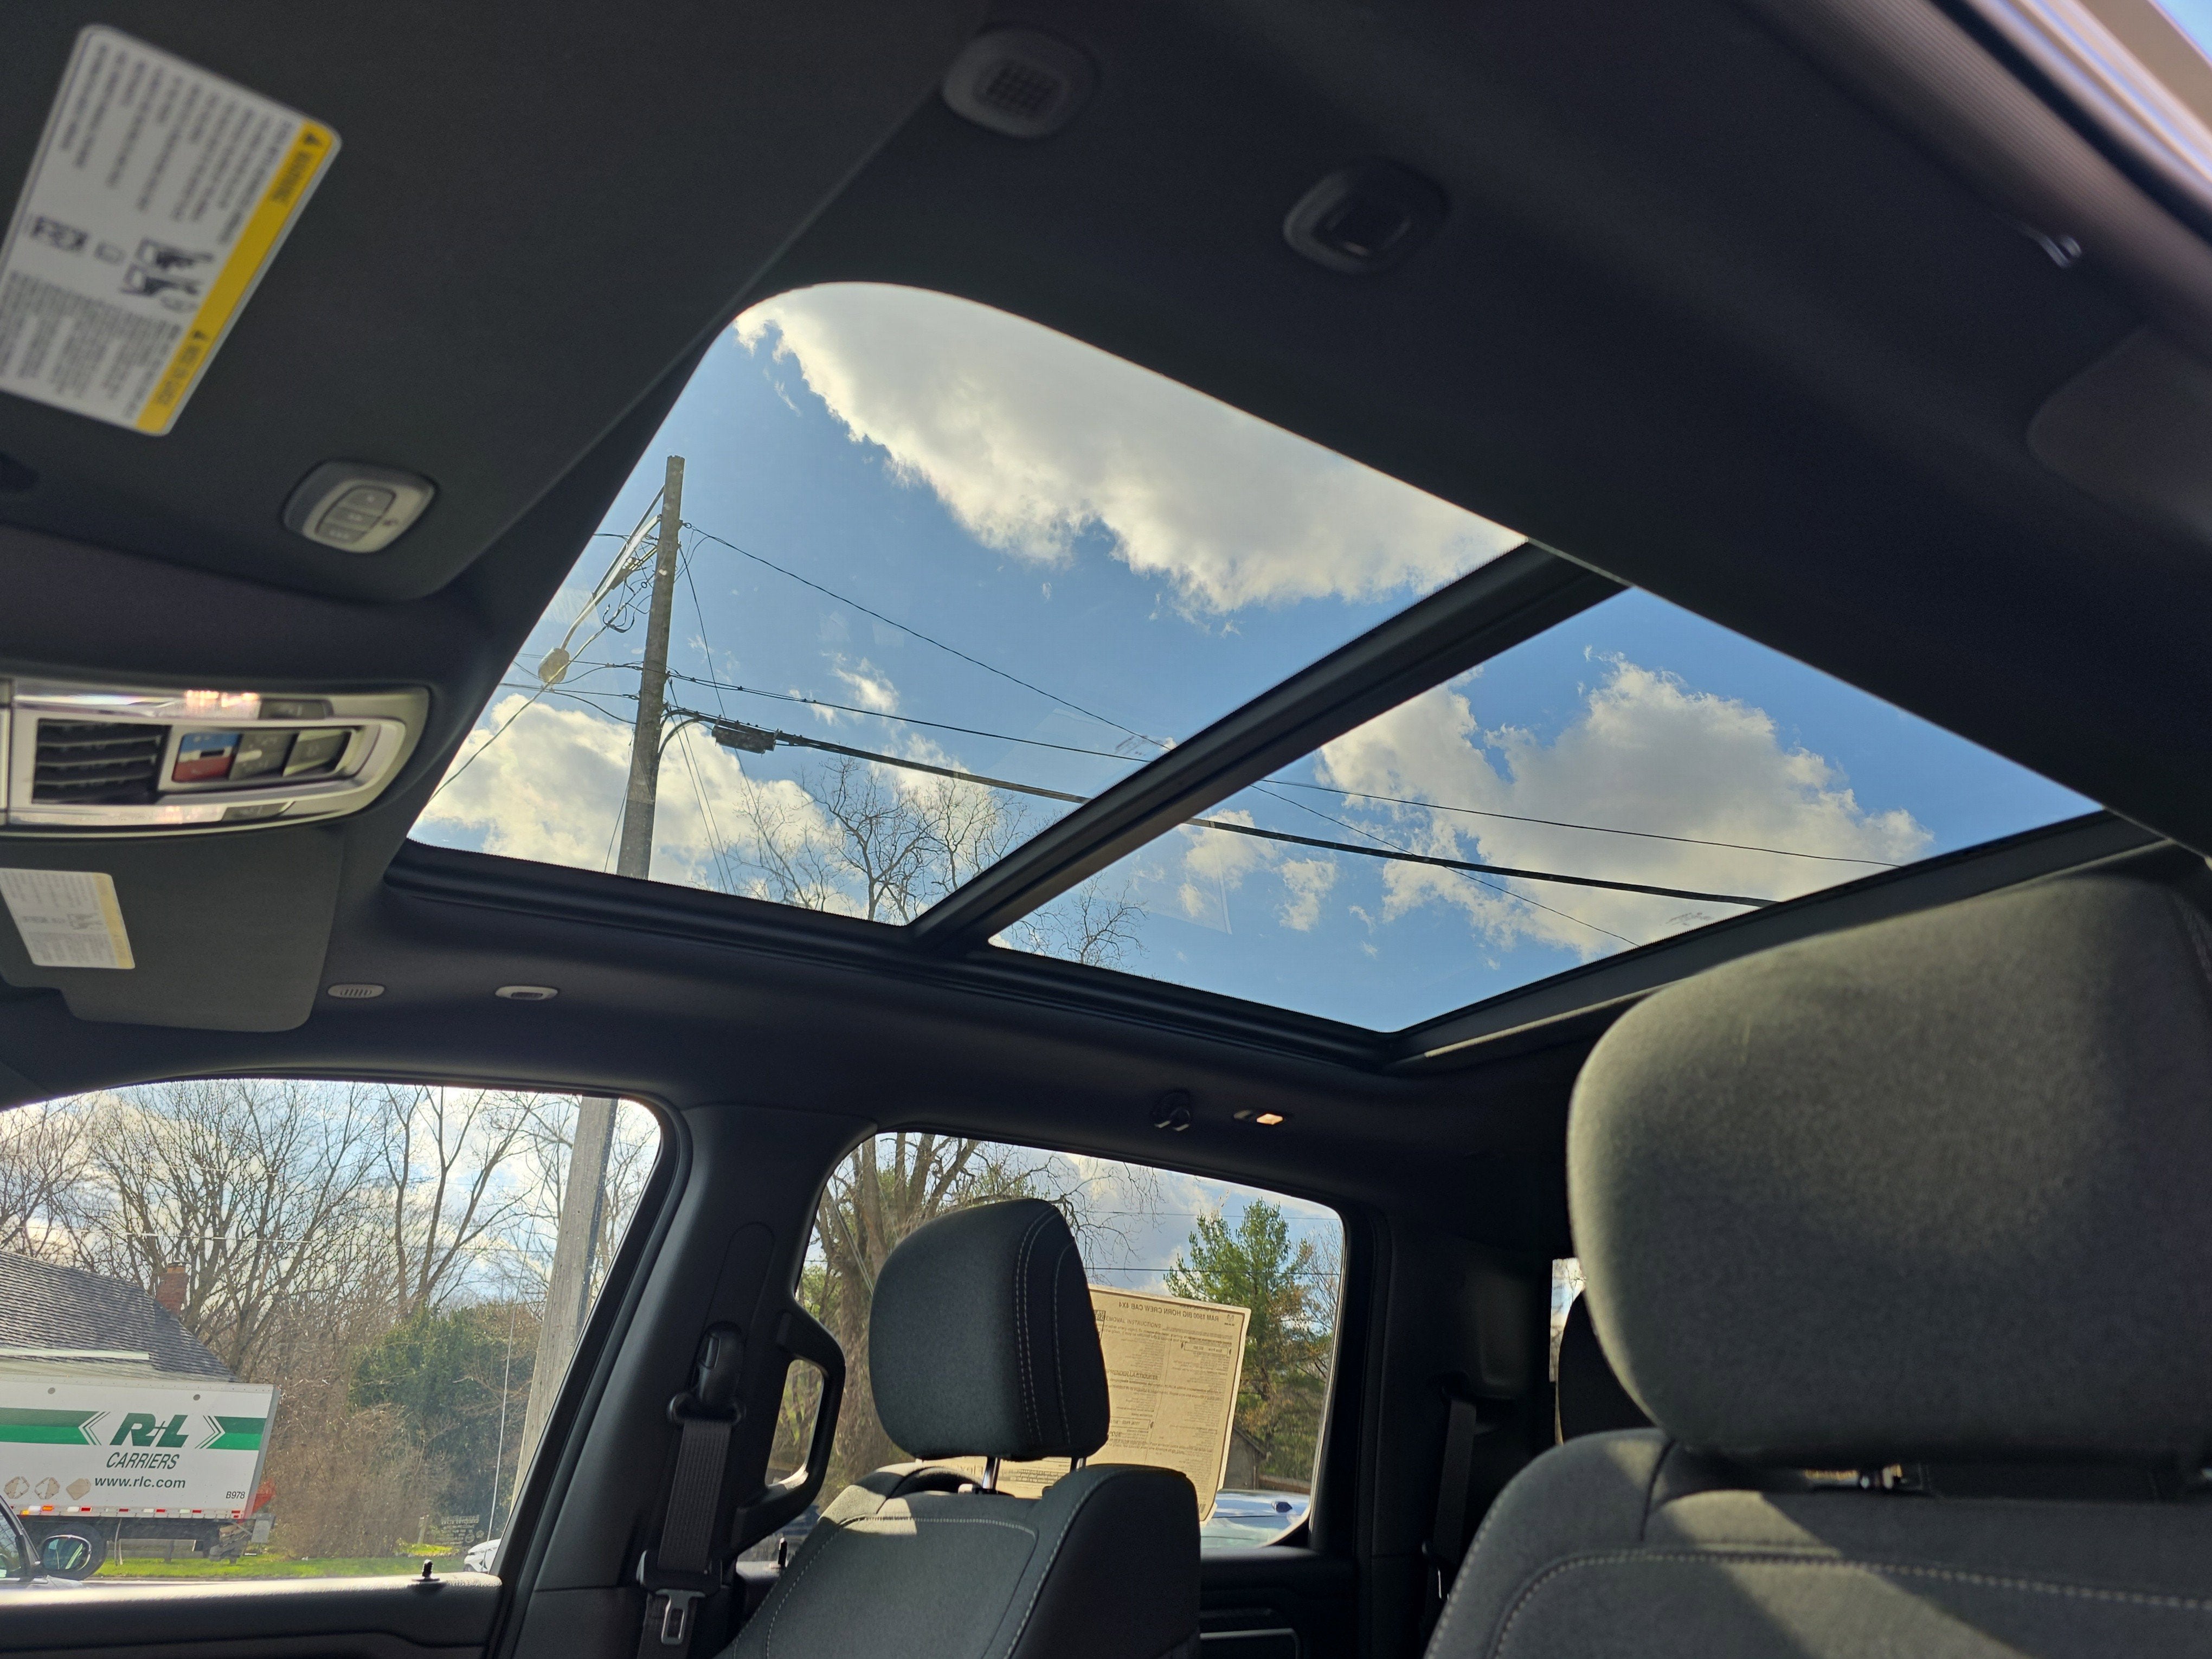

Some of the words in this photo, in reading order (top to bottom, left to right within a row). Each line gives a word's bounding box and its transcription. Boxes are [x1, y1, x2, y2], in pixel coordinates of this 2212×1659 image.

[1105, 1315, 1126, 1323] EMOVAL
[1127, 1319, 1161, 1329] INSTRUCTIONS
[106, 1452, 180, 1470] CARRIERS
[94, 1476, 186, 1489] www.rlc.com
[226, 1491, 246, 1500] B978
